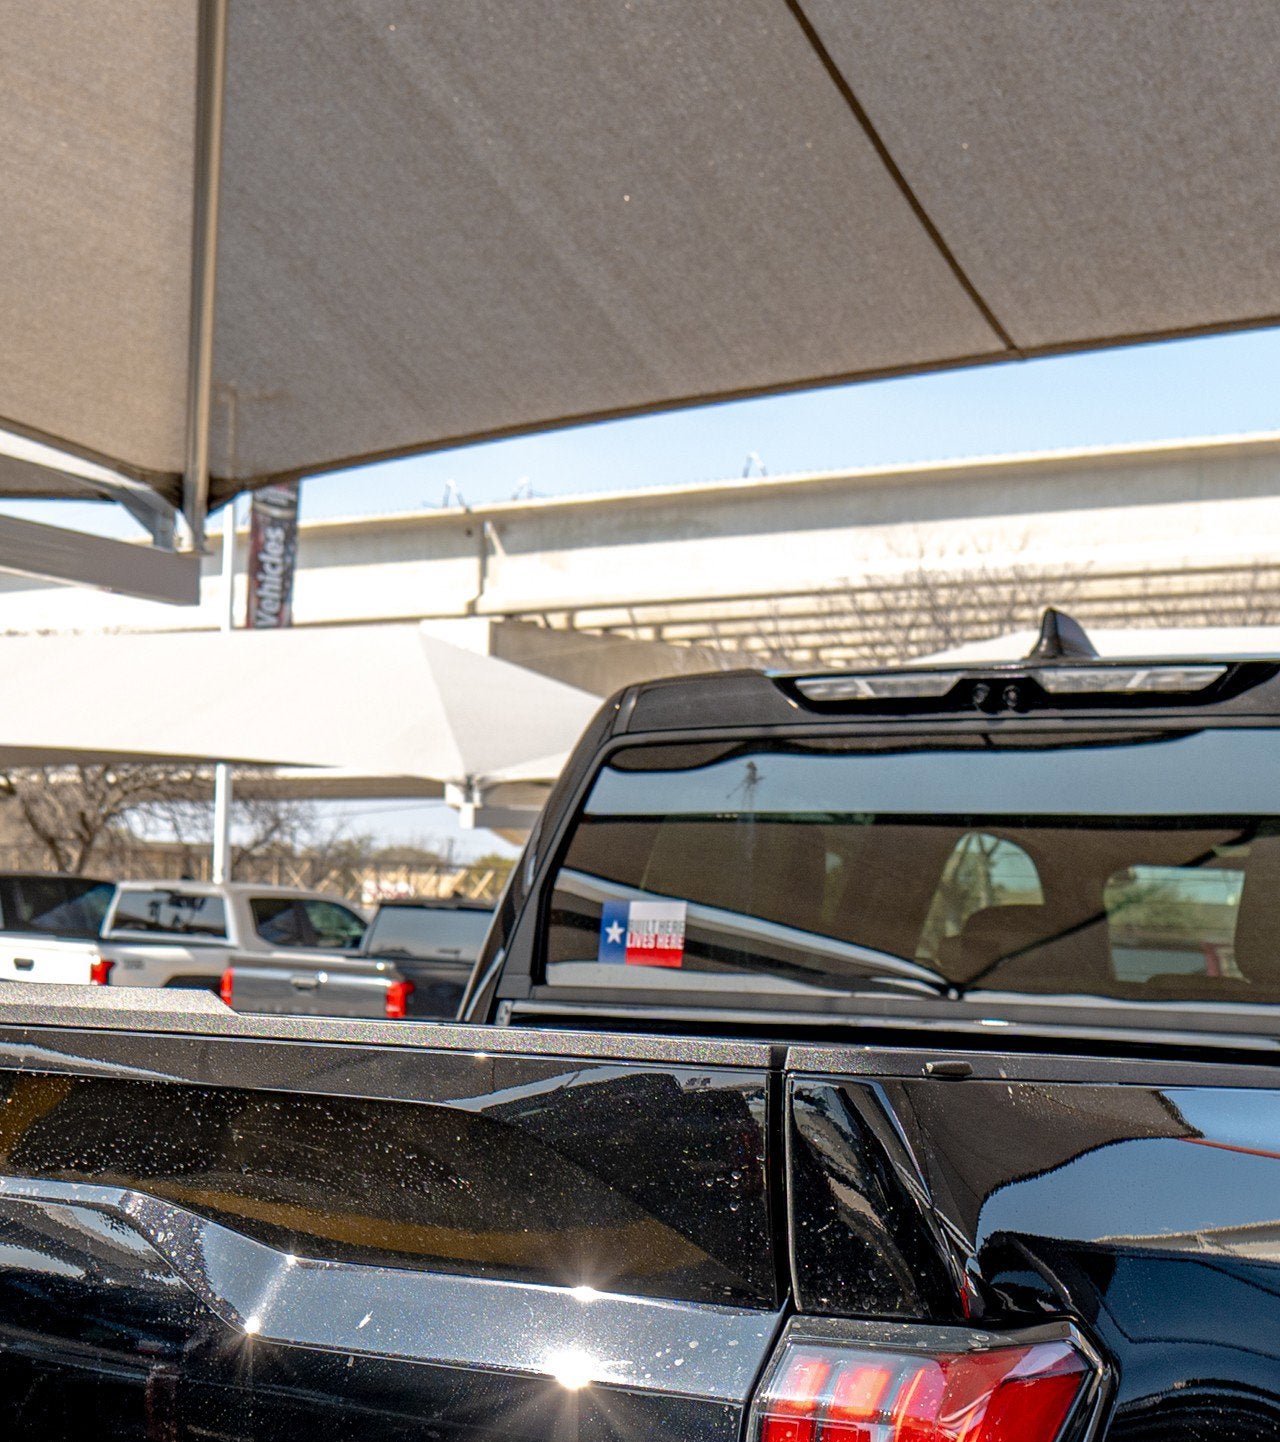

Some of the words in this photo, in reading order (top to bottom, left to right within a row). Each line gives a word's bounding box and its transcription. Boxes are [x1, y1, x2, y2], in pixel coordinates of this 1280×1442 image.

[255, 526, 286, 627] Vehicles
[629, 919, 657, 934] BUILT
[658, 920, 686, 935] HERE
[627, 932, 655, 949] LIVES
[657, 933, 685, 950] HERE
